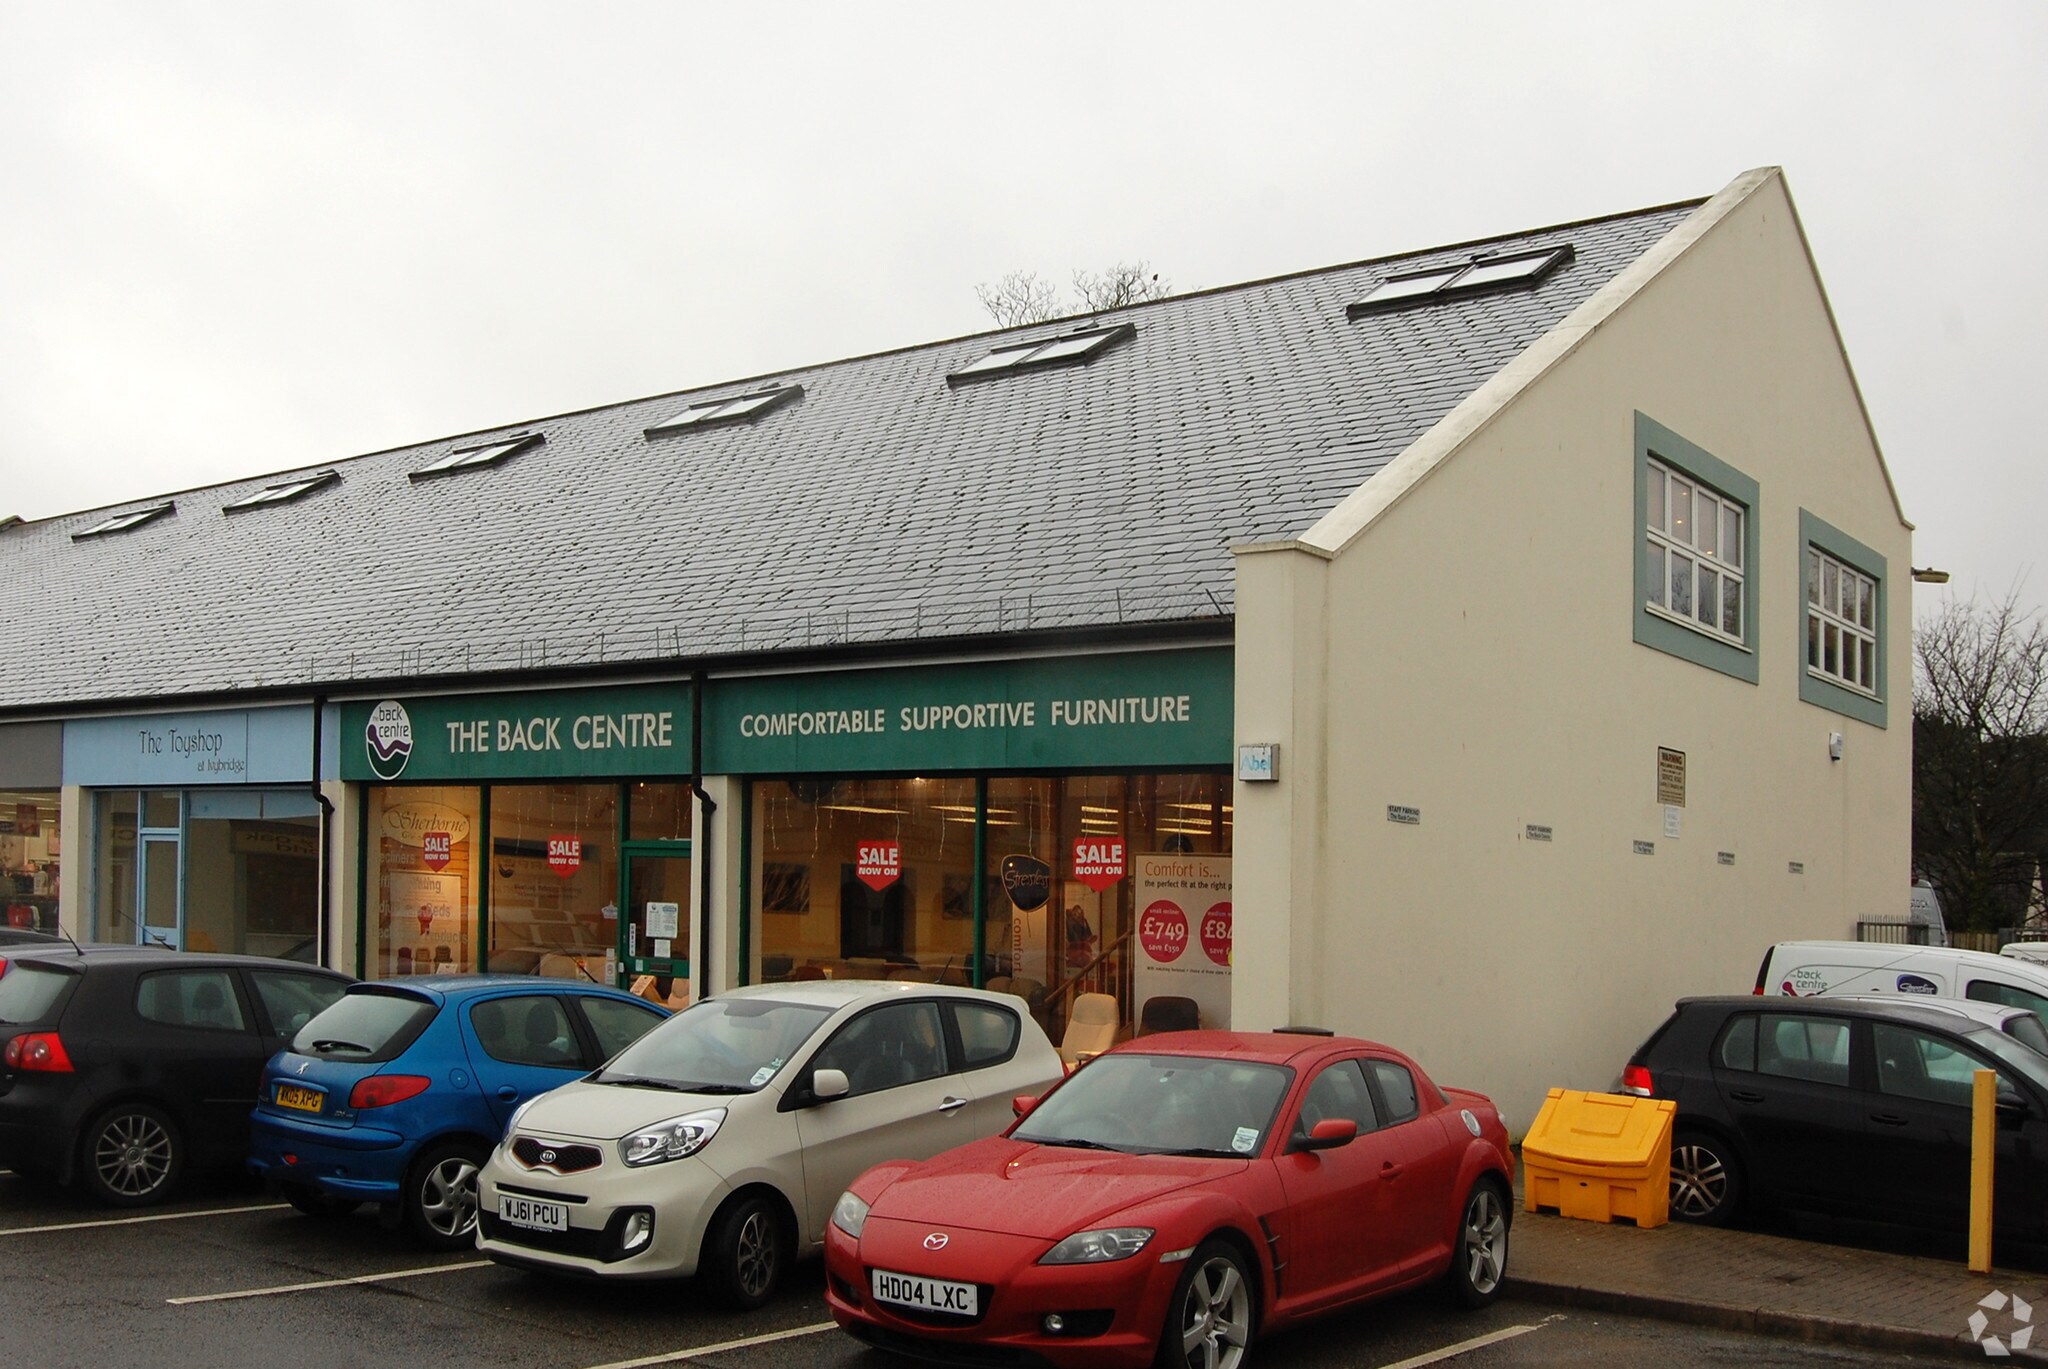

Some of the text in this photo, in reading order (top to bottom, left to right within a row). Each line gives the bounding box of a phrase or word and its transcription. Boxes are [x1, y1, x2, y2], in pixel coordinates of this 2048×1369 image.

[379, 706, 403, 721] back
[740, 695, 1190, 737] COMFORTABLE SUPPORTIVE FURNITURE
[378, 723, 409, 738] centre
[447, 711, 673, 753] THE BACK CENTRE
[139, 727, 223, 758] The Toyshop
[197, 758, 245, 774] at Ivybridge
[388, 810, 467, 832] Sherborne
[425, 837, 449, 852] SALE
[550, 840, 579, 856] SALE
[860, 847, 898, 865] SALE
[1076, 845, 1122, 863] SALE
[859, 867, 898, 875] NOW ON
[1075, 866, 1122, 875] NOW ON
[1145, 861, 1221, 878] Comfort is...
[1004, 869, 1049, 890] Stressless
[1144, 880, 1155, 888] the
[1157, 880, 1179, 889] perfect
[1198, 881, 1208, 889] the
[1210, 882, 1226, 891] right
[1143, 917, 1185, 941] £749
[1013, 917, 1024, 972] comfort
[1164, 943, 1180, 953] £350
[1797, 970, 1821, 979] back
[1796, 980, 1827, 989] centre
[300, 1089, 319, 1108] XPG
[505, 1199, 559, 1225] WJ61 PCU
[880, 1275, 968, 1310] HD04 LXC
